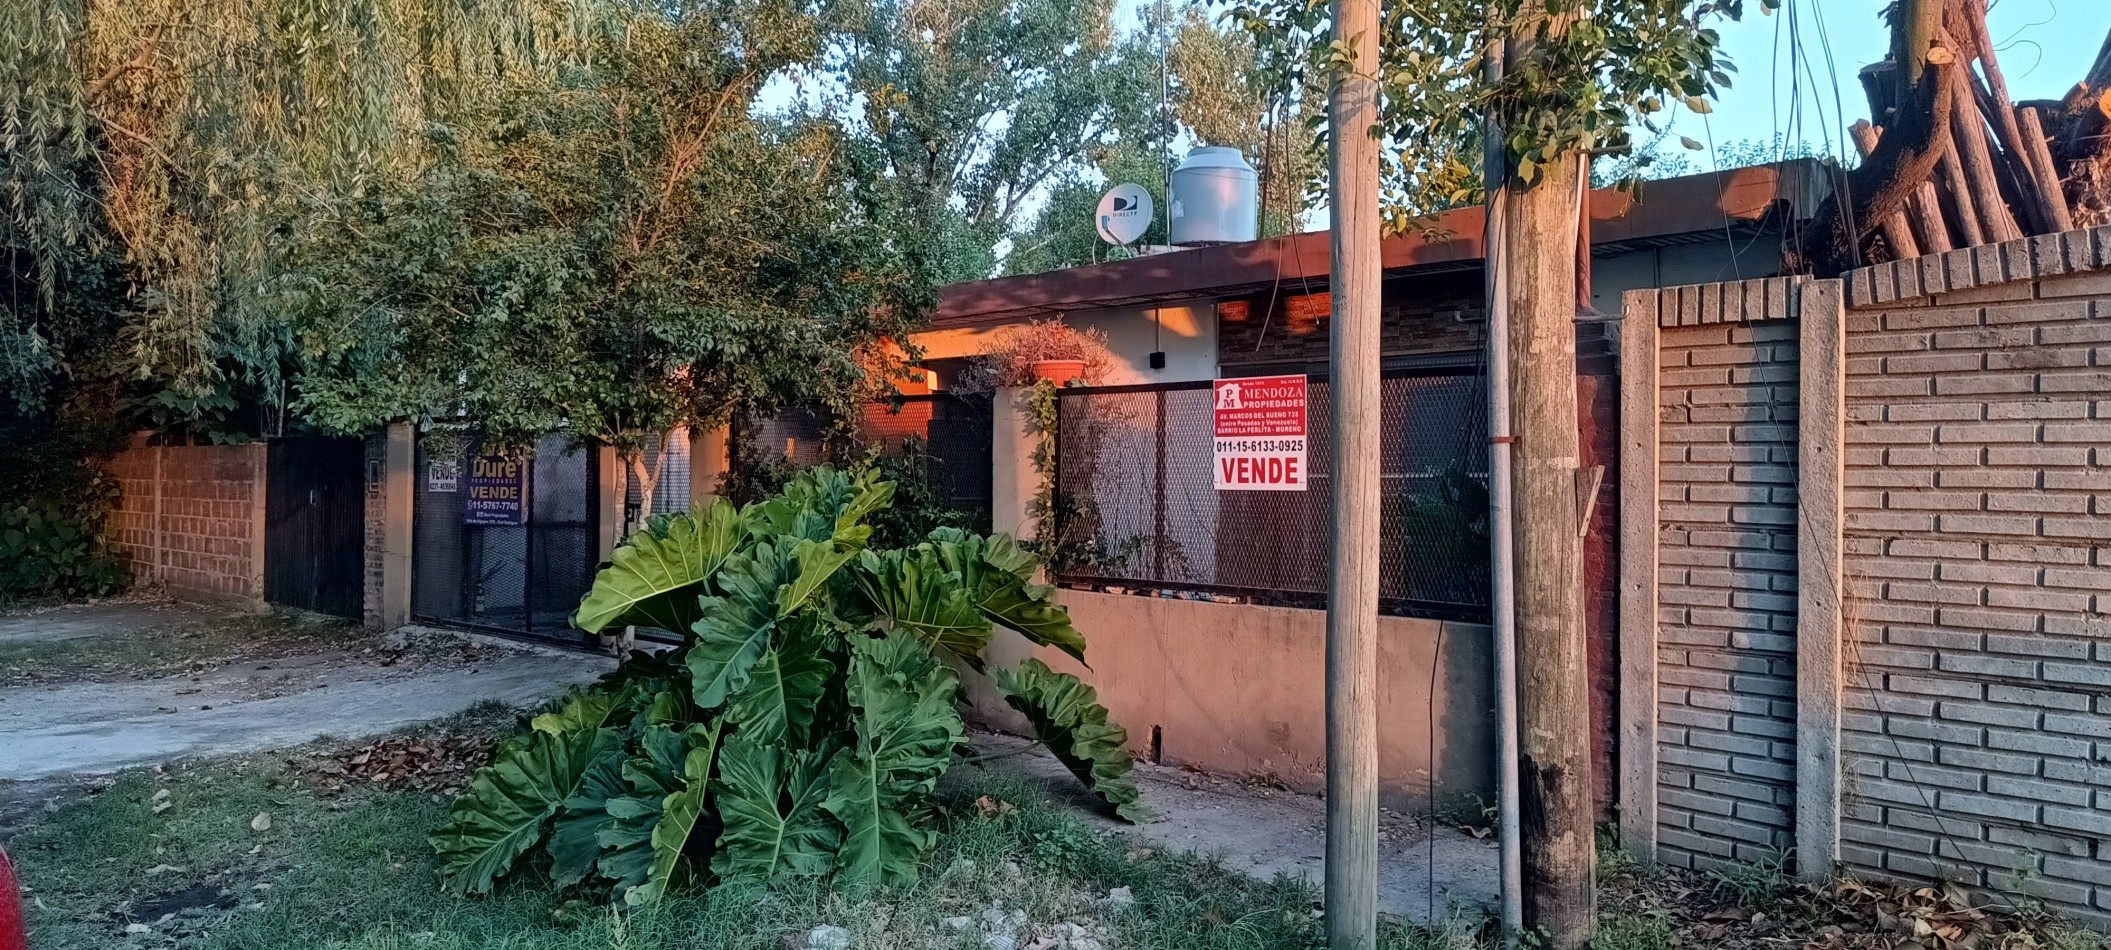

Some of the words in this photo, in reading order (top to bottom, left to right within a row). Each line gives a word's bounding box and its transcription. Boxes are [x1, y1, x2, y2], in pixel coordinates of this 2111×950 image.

[1226, 389, 1233, 398] P
[1244, 387, 1303, 399] MENDOZA
[1223, 399, 1235, 408] M
[1243, 399, 1304, 409] PROPIEDADES
[1276, 425, 1302, 433] MORENO
[1216, 440, 1303, 452] 011-15-6133-0925
[1221, 457, 1298, 484] VENDE
[470, 486, 518, 499] VENDE
[473, 500, 518, 510] 11-5767-7740
